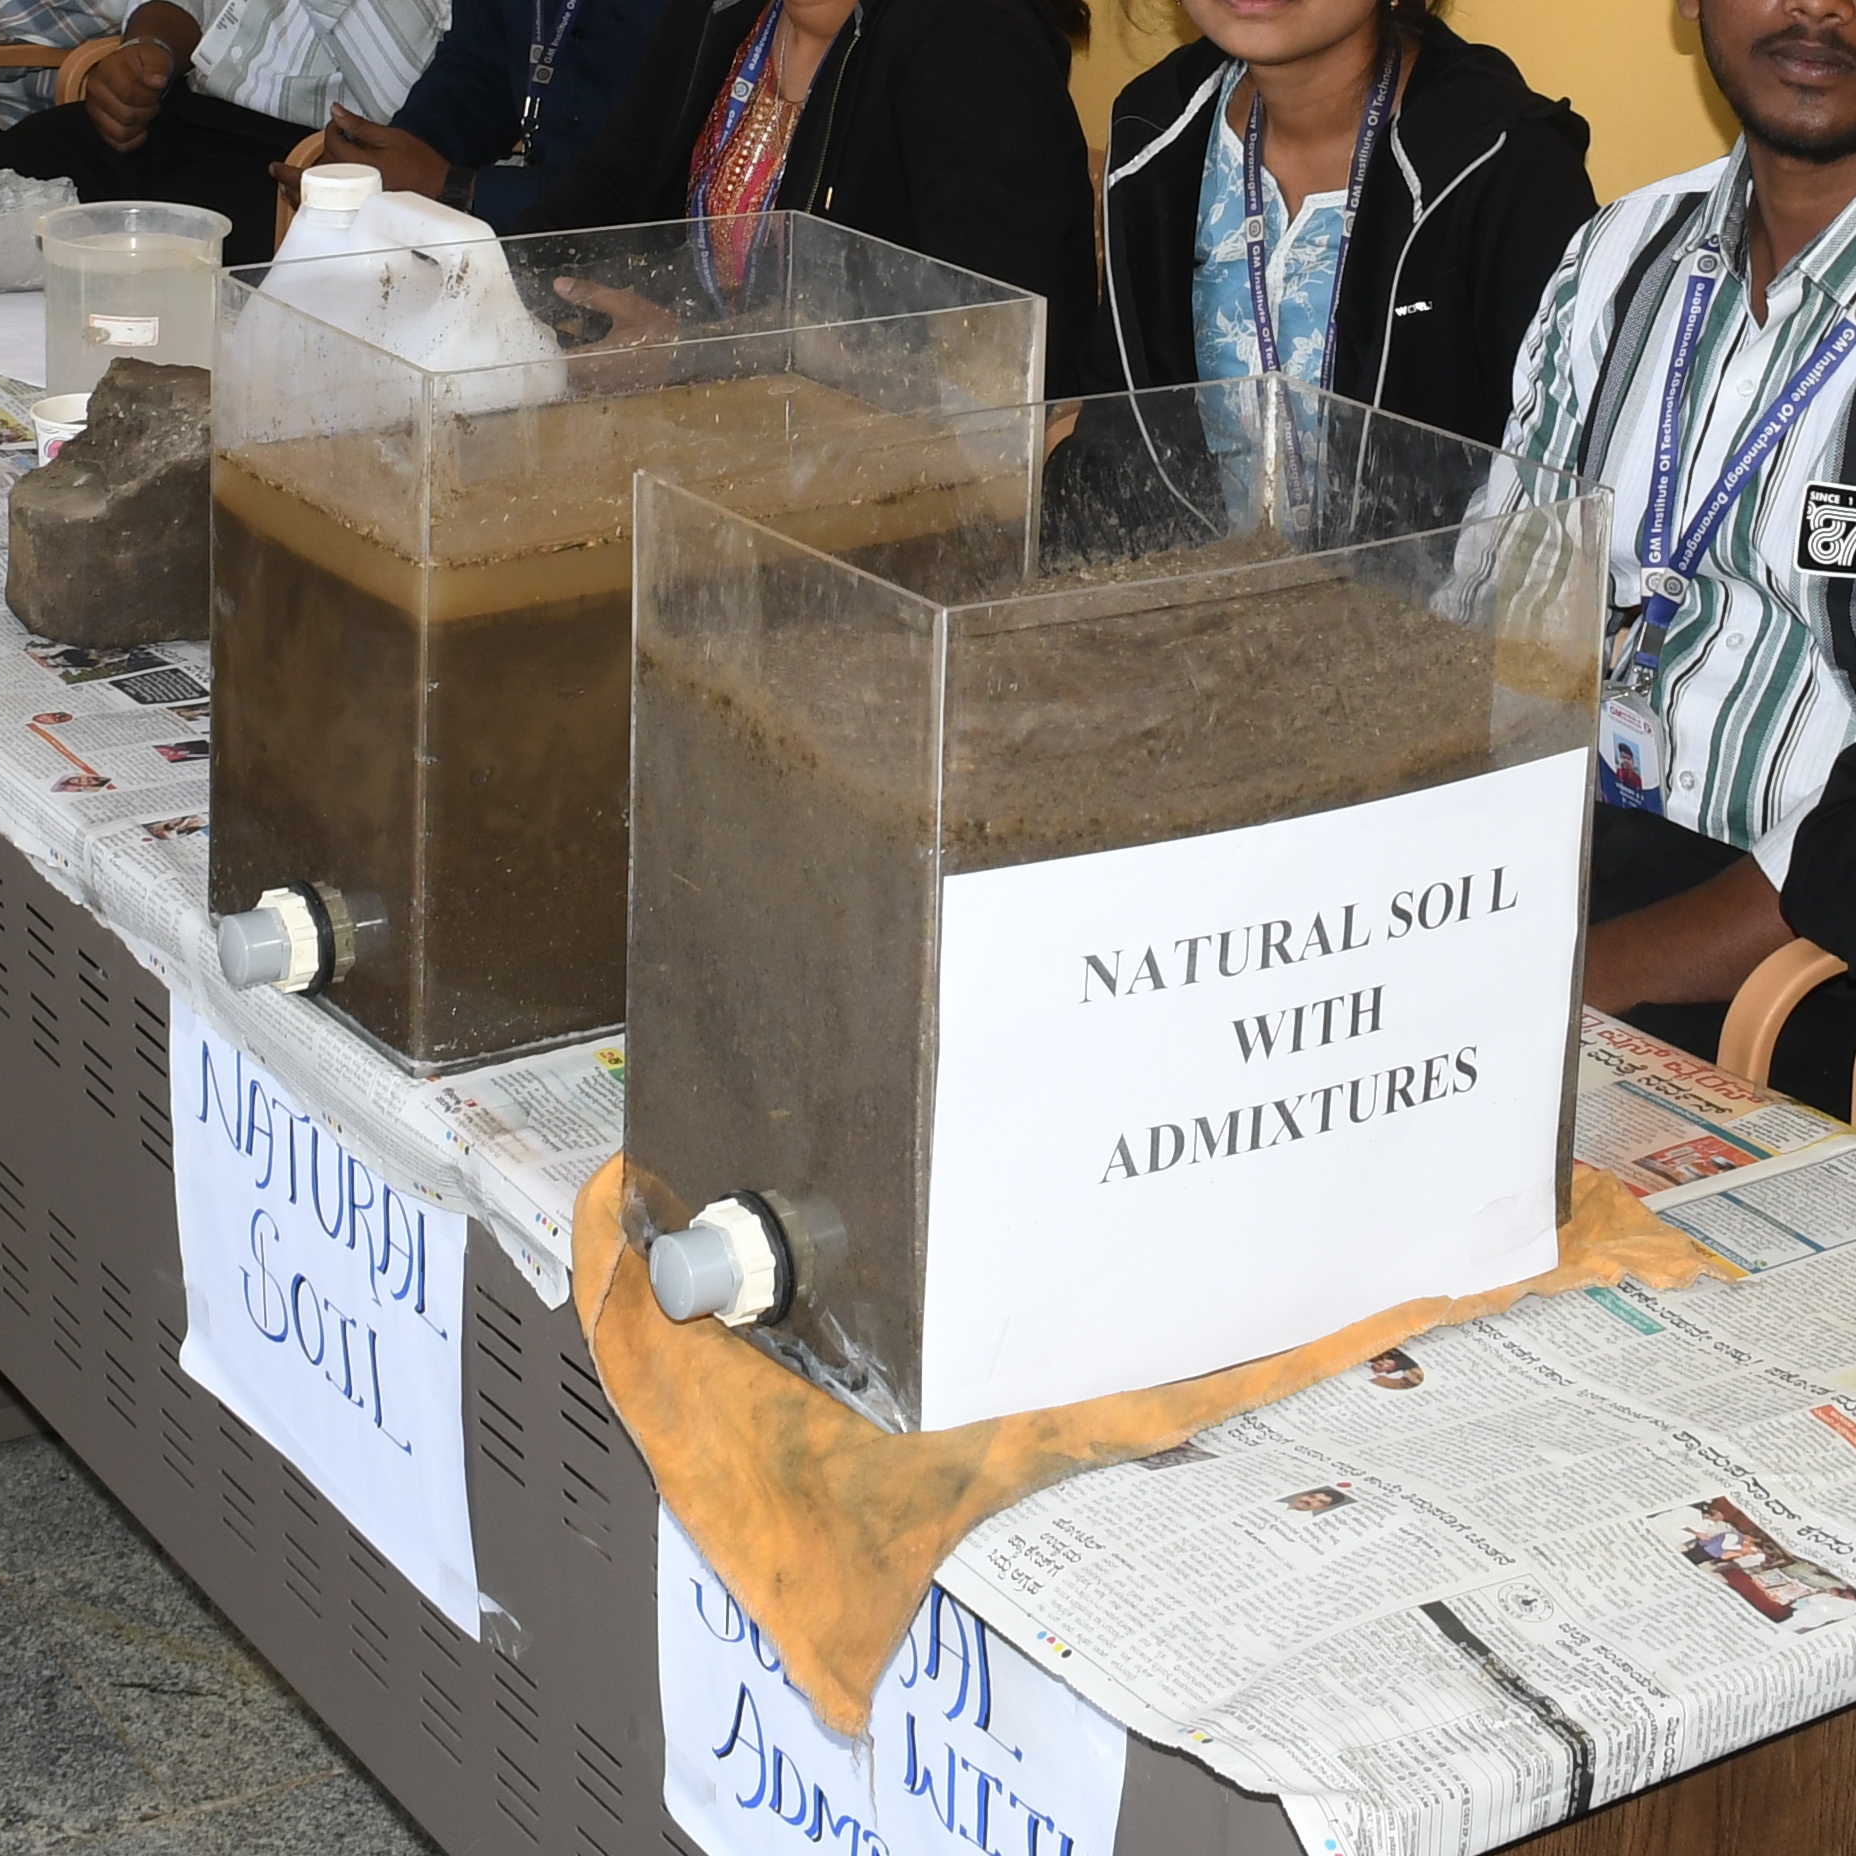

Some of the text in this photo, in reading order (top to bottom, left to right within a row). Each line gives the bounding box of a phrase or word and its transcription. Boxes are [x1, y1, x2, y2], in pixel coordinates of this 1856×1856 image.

[544, 47, 556, 64] GM
[550, 11, 571, 47] Institute
[1354, 129, 1374, 182] Institute
[1367, 109, 1380, 126] Of
[1247, 132, 1258, 211] Davanagere
[1350, 185, 1362, 208] GM
[1252, 245, 1272, 342] GM Institute Of
[1648, 282, 1705, 563] GM Institute Of Technology Davanagere
[1678, 328, 1855, 571] GM Institute Of Technology Davanagere
[1810, 491, 1841, 504] SINCE
[1078, 866, 1519, 1004] NATURAL SOIL
[1231, 985, 1385, 1065] WITH
[1099, 1046, 1479, 1185] ADMIXTURES
[197, 1040, 448, 1341] NATURAL
[239, 1208, 412, 1456] SOIL
[1555, 1638, 1582, 1658] Office
[1609, 1673, 1635, 1699] Chief
